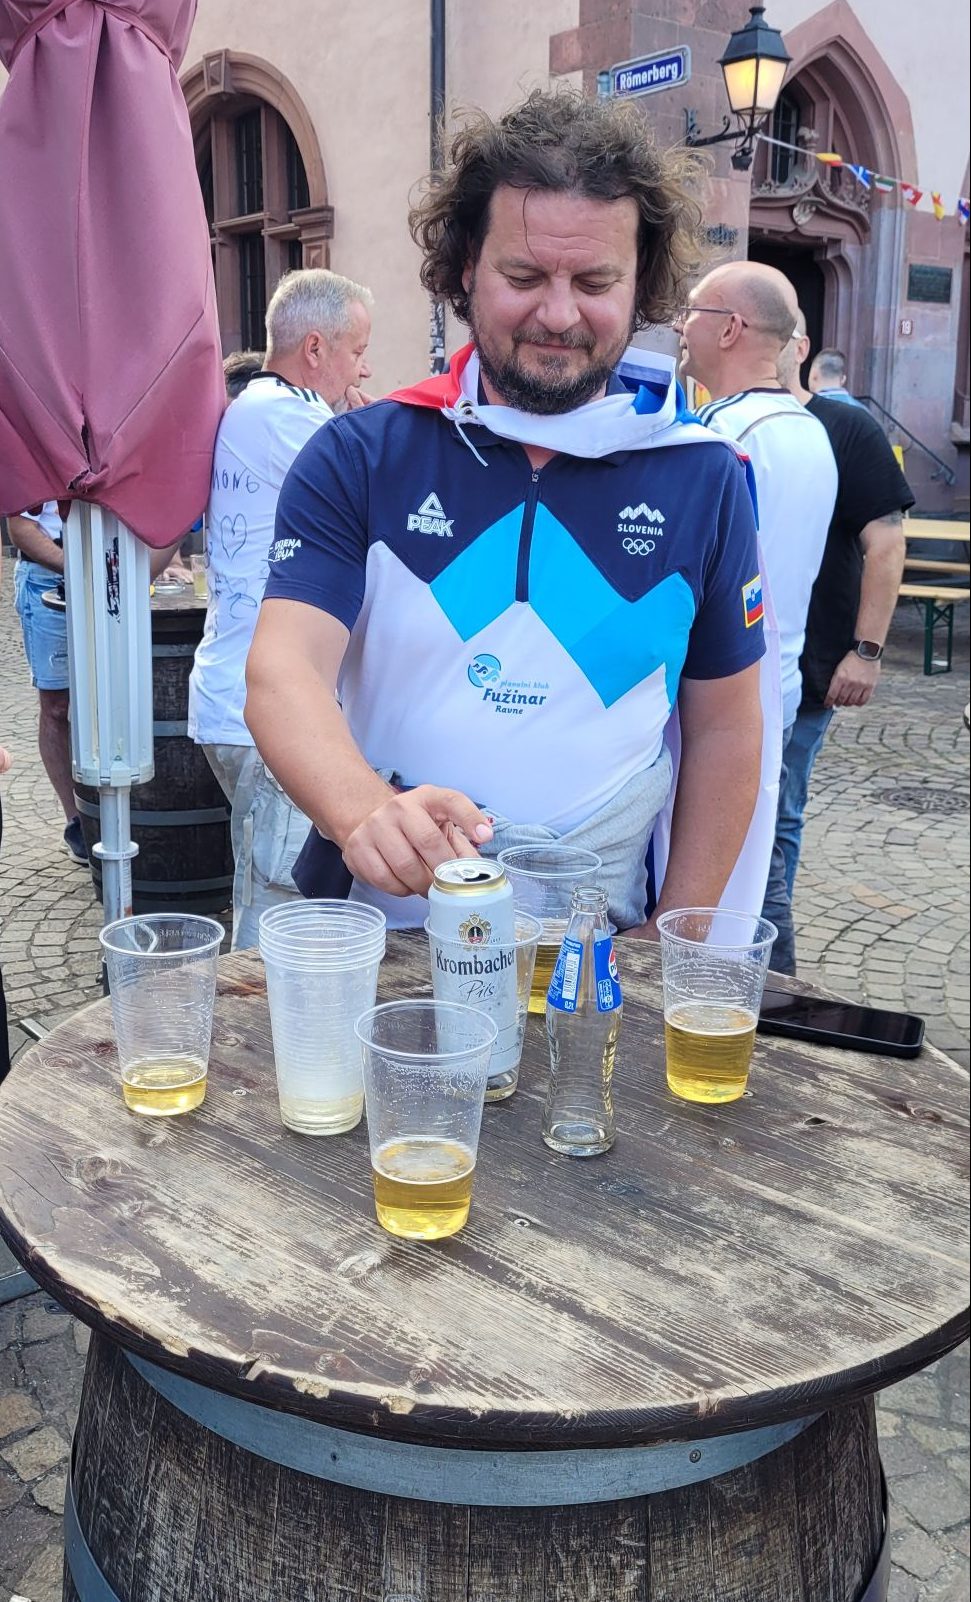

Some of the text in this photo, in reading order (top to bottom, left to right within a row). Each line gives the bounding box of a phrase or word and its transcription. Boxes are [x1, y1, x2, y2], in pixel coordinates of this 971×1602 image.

[620, 62, 679, 90] Römerberg
[407, 513, 455, 537] PEAK
[617, 523, 664, 536] SLOVENIA
[483, 688, 546, 705] Fužinar
[495, 705, 523, 714] Ravne
[435, 947, 515, 976] Krombacher
[459, 980, 495, 1001] Pils
